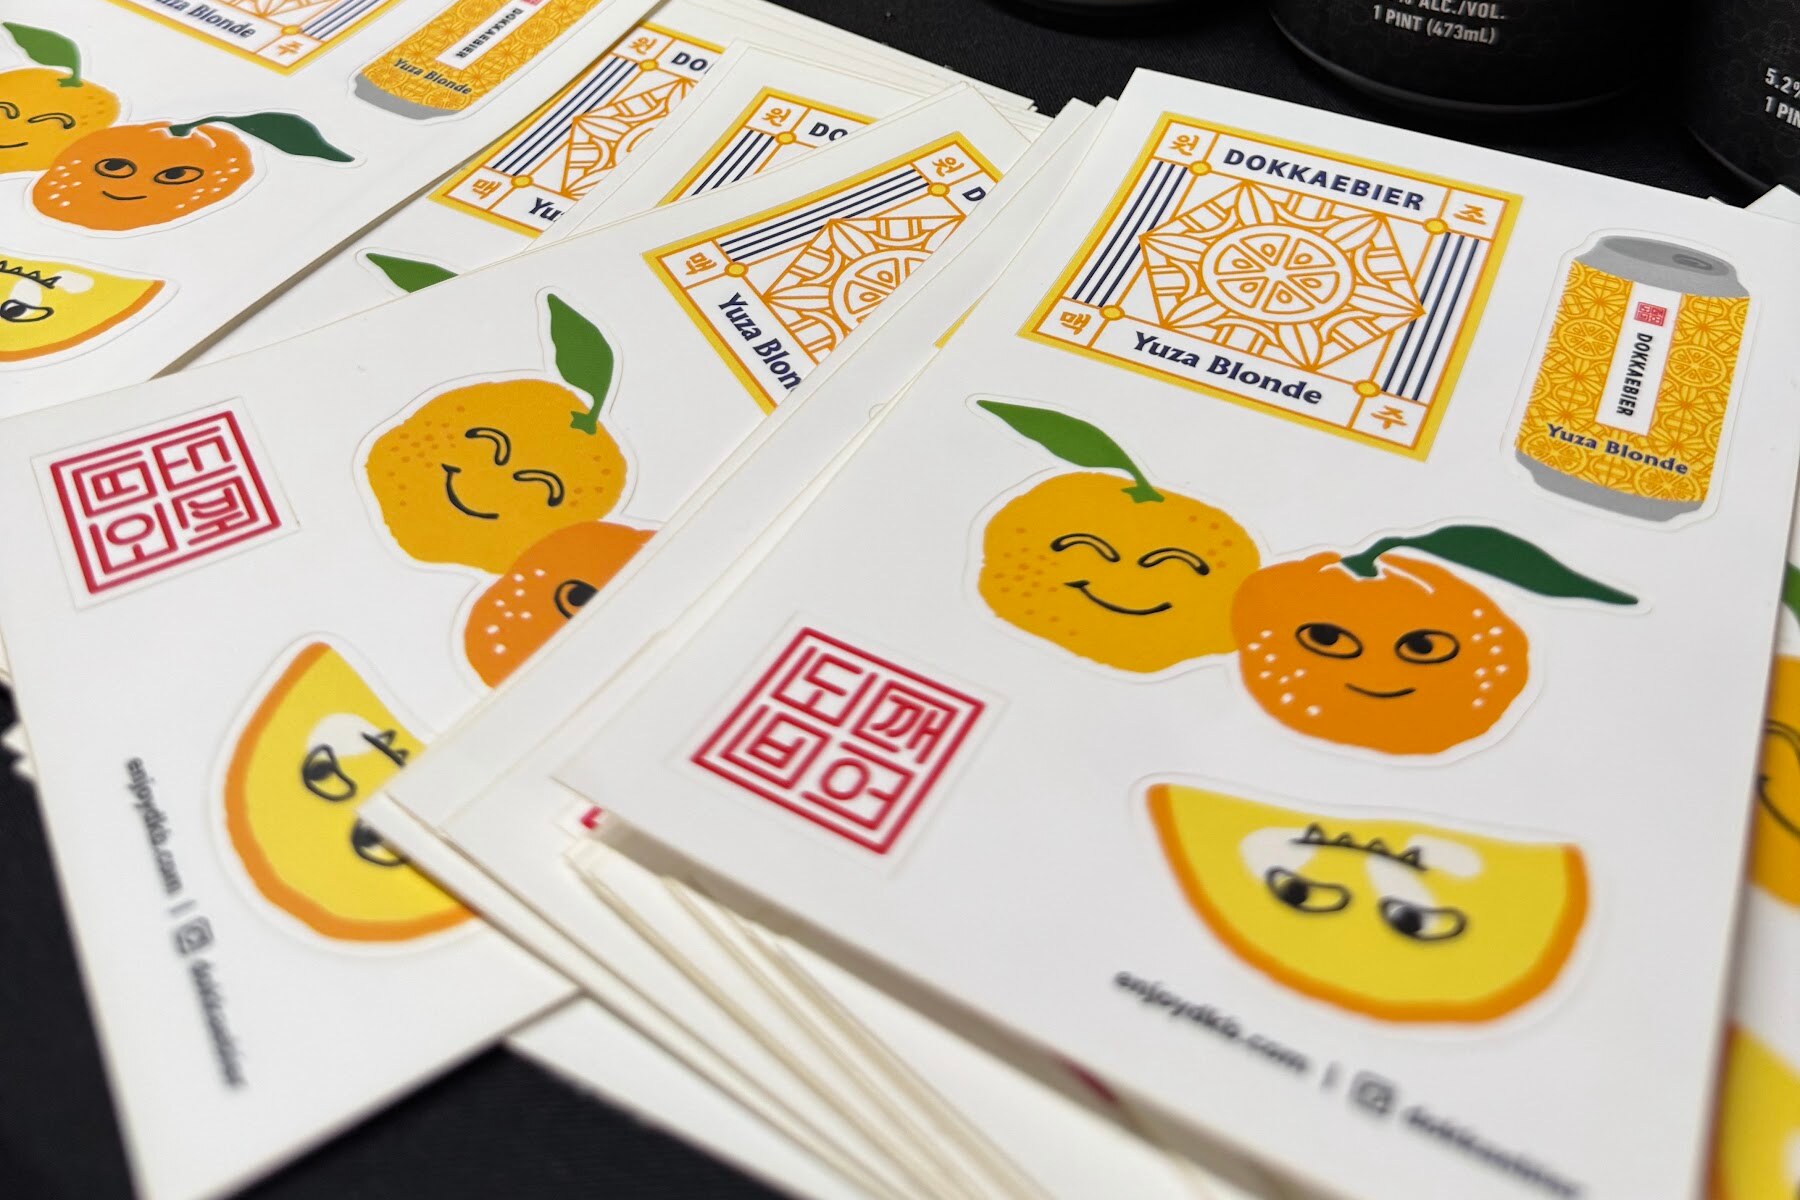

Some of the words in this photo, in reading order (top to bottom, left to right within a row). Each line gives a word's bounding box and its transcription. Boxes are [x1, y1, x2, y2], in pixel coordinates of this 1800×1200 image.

[455, 7, 525, 59] DOKKAEBIER
[1373, 4, 1382, 20] 1
[1385, 8, 1423, 32] PINT
[1426, 17, 1496, 45] (473mL)
[393, 58, 424, 77] Yuza
[424, 70, 473, 96] Blonde
[1764, 95, 1774, 113] 1
[1222, 147, 1426, 212] DOKKAEBIER
[718, 291, 763, 342] Yuza
[752, 337, 803, 394] Blon
[1131, 330, 1202, 373] Yuza
[1207, 354, 1324, 407] Blonde
[1615, 332, 1654, 418] DOKKAEBIER
[1370, 405, 1408, 431] 주
[1546, 422, 1598, 450] Yuza
[1604, 440, 1689, 475] Blonde
